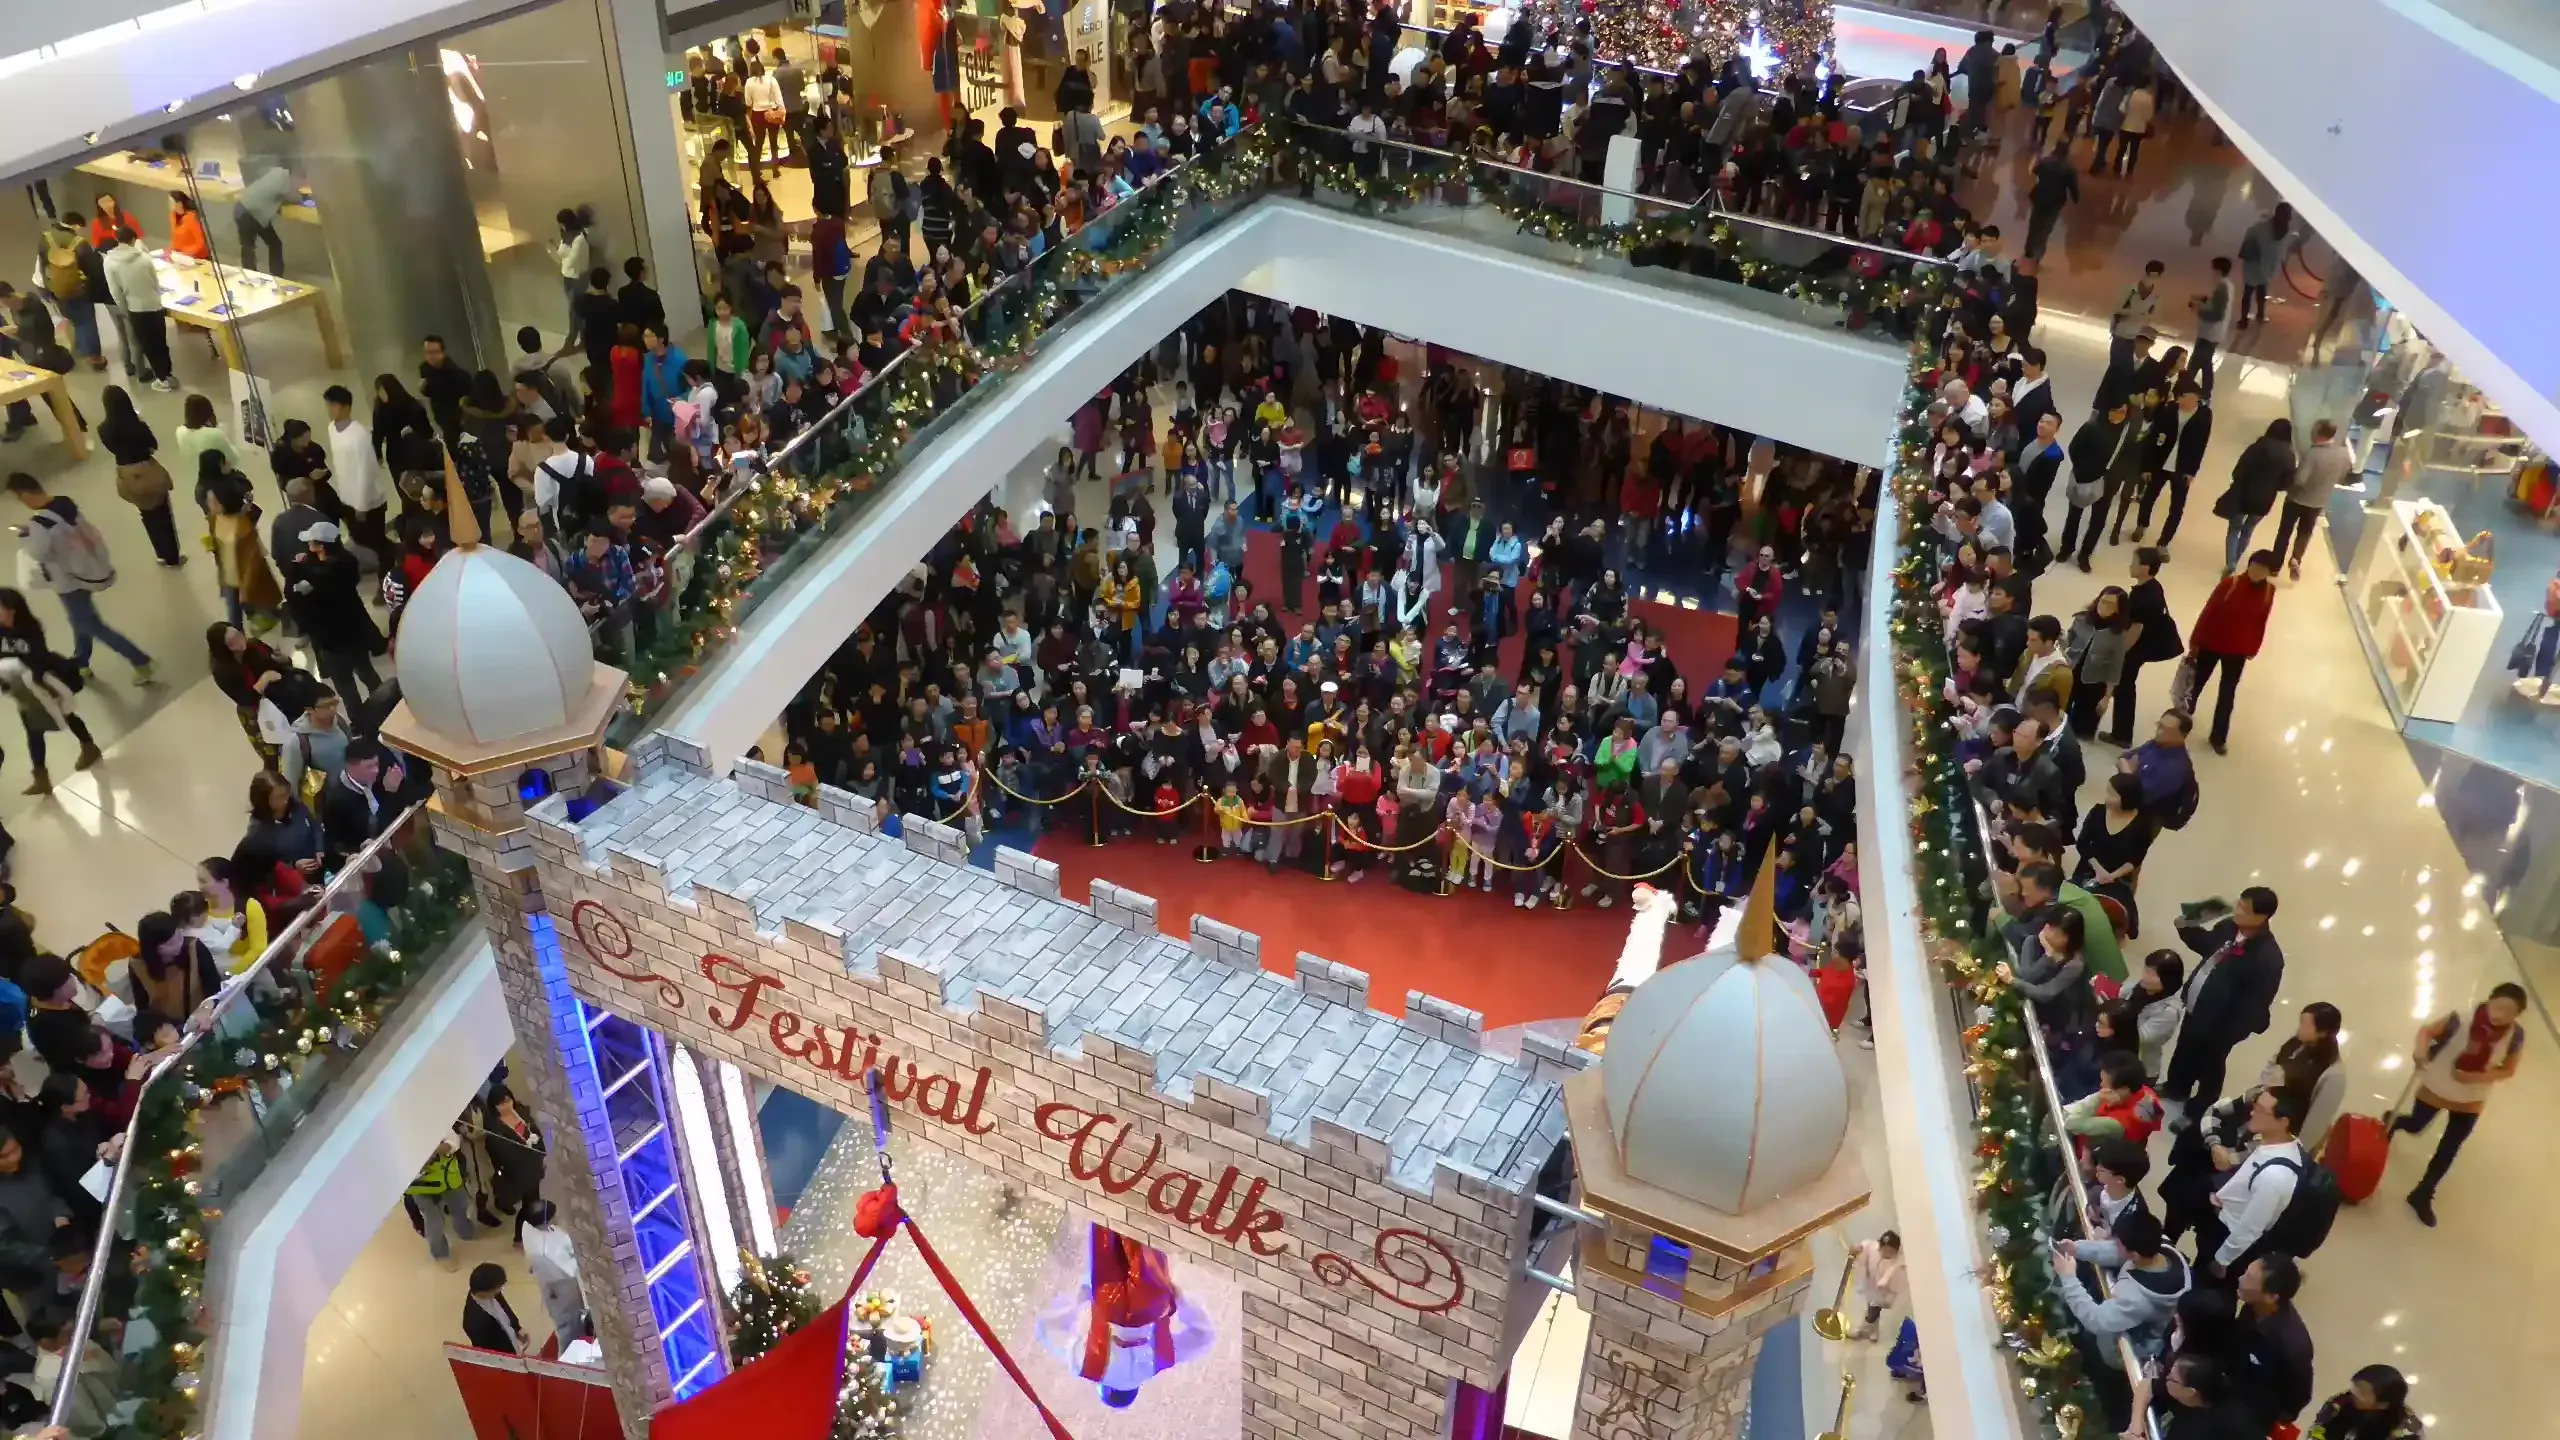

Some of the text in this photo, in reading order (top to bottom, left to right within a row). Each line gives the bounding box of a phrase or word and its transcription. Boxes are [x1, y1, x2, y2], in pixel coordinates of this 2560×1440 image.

[967, 84, 997, 113] LOVE
[700, 953, 1289, 1257] Festival Walk
